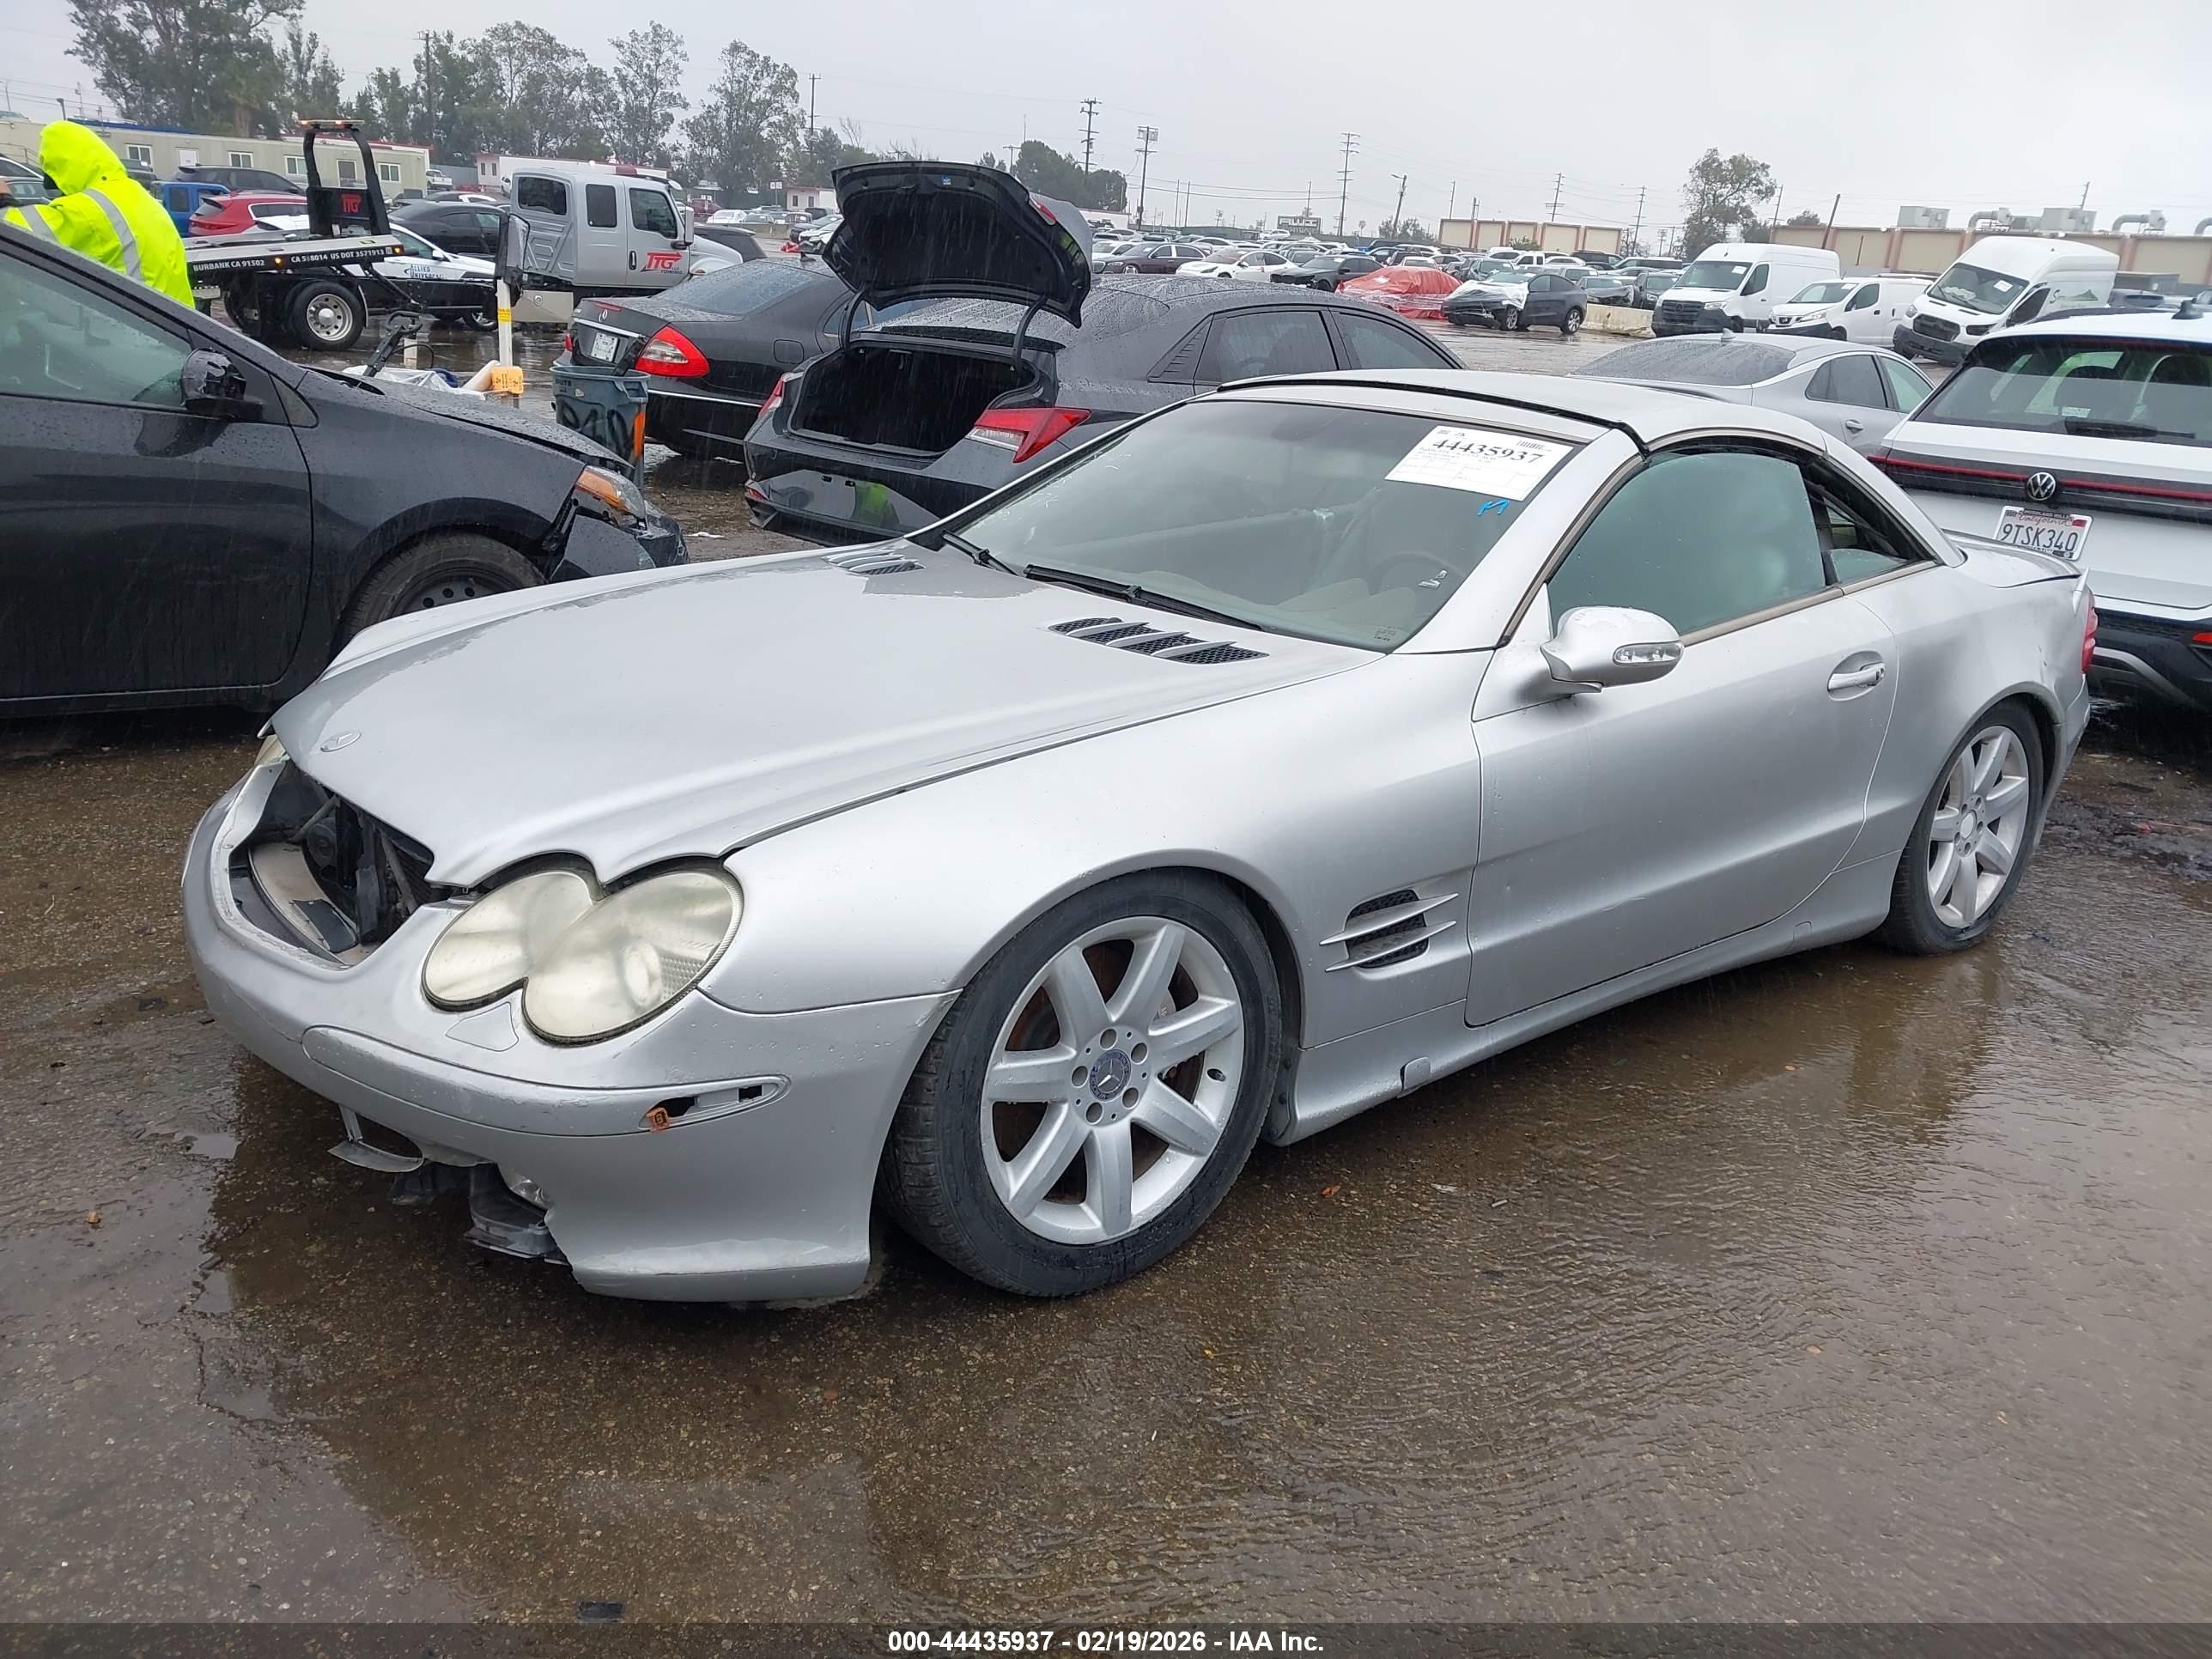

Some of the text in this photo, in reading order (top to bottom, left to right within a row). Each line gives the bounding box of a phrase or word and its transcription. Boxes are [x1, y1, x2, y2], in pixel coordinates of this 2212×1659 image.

[341, 251, 355, 259] DOT
[356, 248, 384, 258] 3571913
[193, 261, 230, 272] BURBANK
[1432, 439, 1544, 464] 44435937
[2001, 524, 2078, 551] 9TSK340
